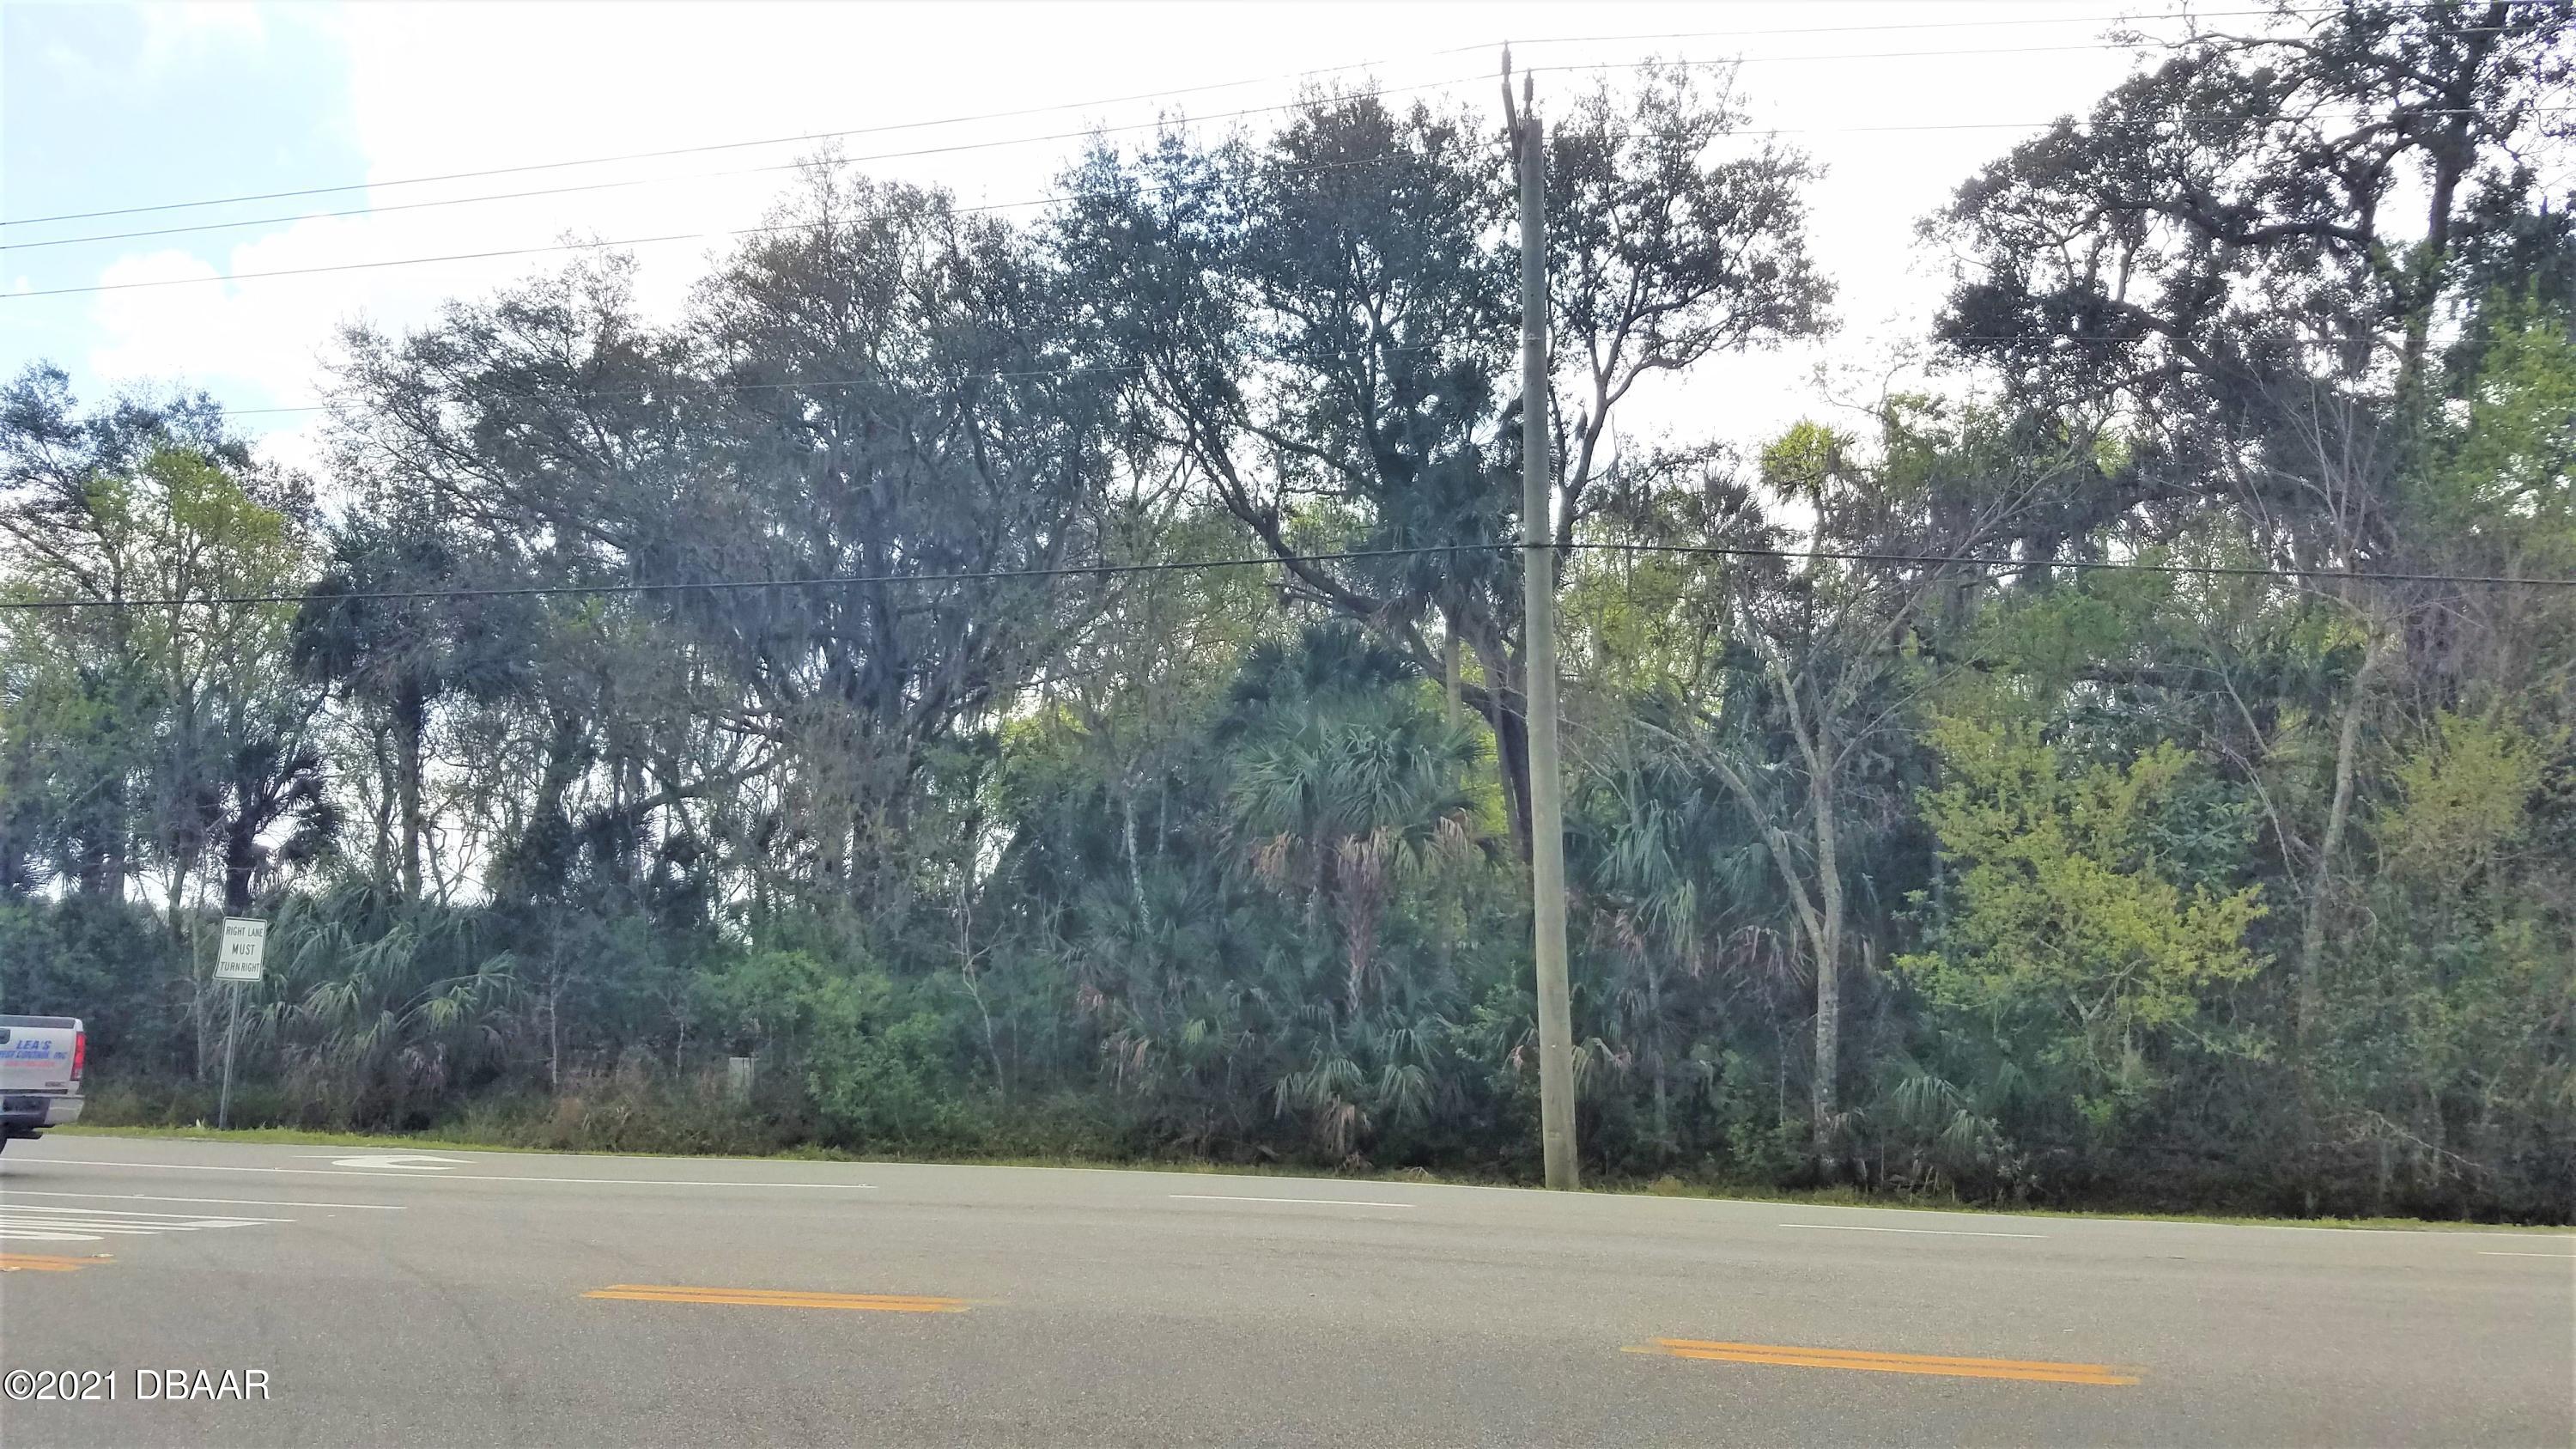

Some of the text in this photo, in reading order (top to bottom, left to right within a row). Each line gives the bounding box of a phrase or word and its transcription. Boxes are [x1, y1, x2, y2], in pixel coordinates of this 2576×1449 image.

[226, 926, 264, 937] RIGHT LANE
[232, 943, 255, 955] MUST
[220, 961, 260, 972] TURN RIGHT
[16, 1040, 52, 1050] LEA'S
